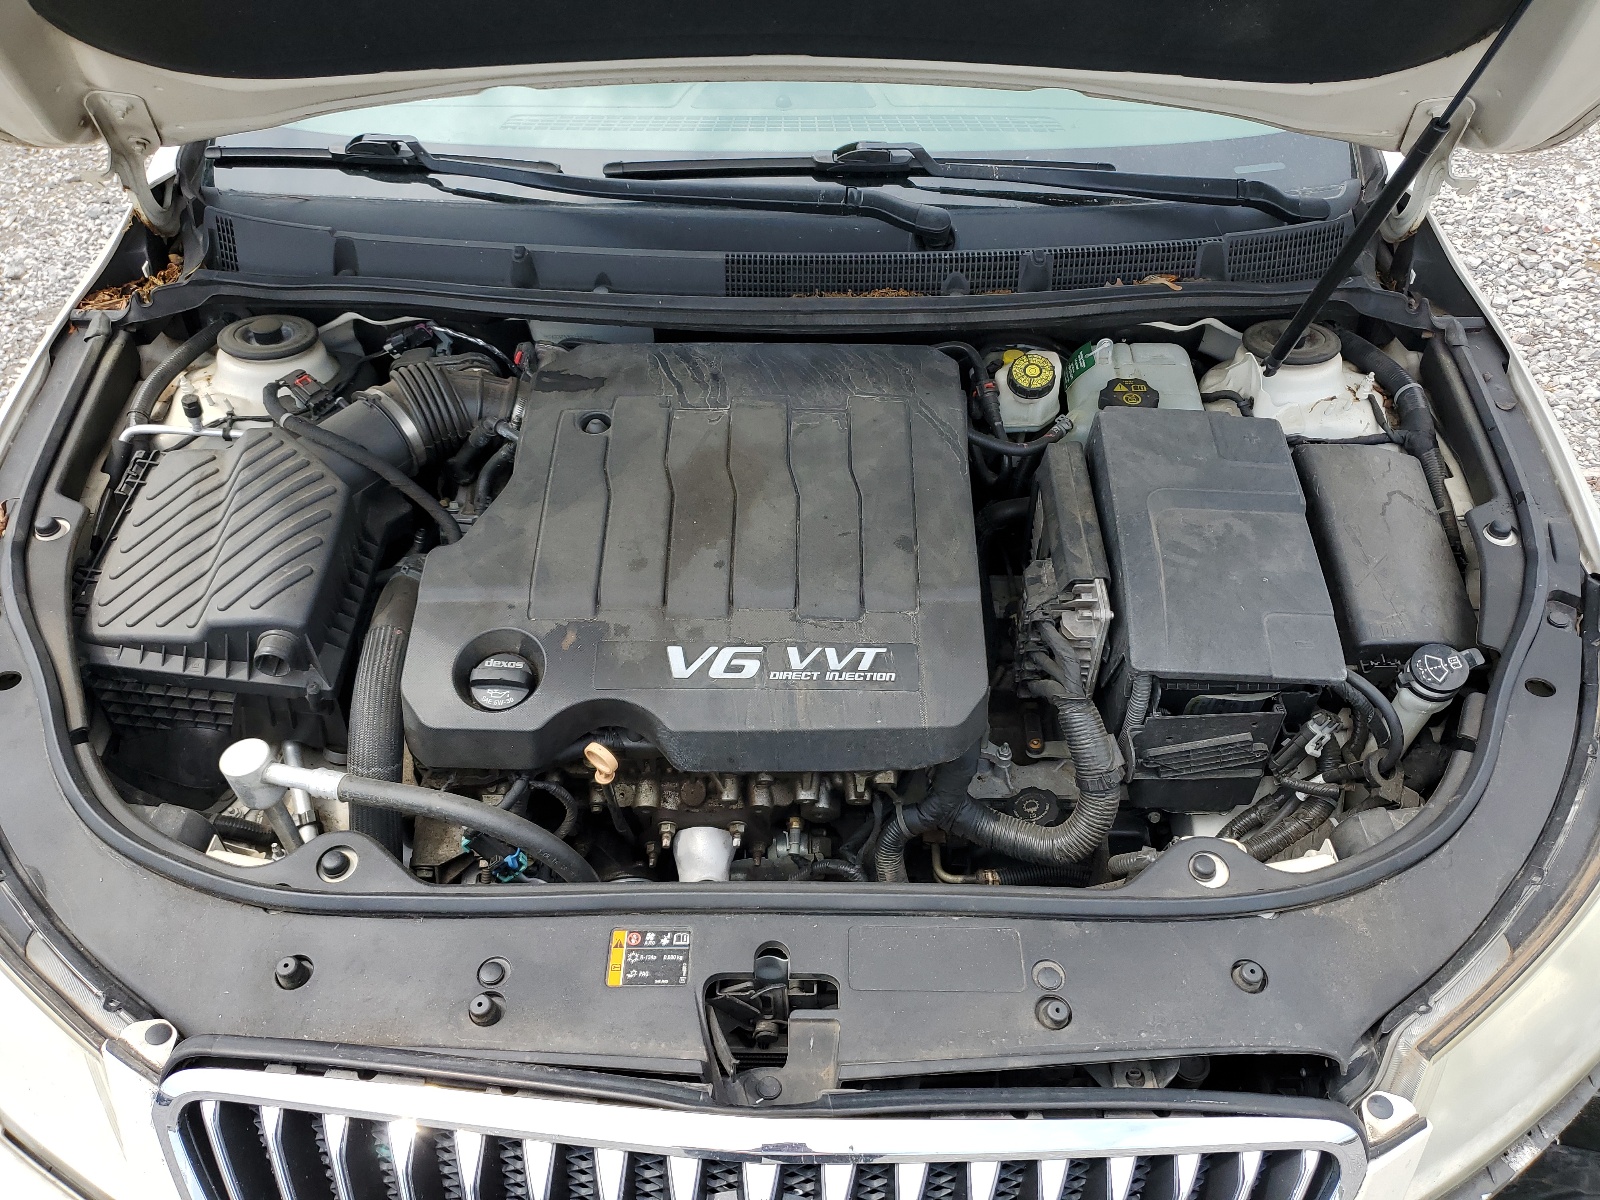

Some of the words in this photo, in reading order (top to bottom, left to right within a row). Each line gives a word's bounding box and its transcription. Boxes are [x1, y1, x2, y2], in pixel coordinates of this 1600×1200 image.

[484, 658, 526, 669] dexos
[666, 645, 764, 679] V6
[786, 646, 887, 671] VVT
[769, 671, 821, 681] DIRECT
[825, 672, 896, 682] INJECTION
